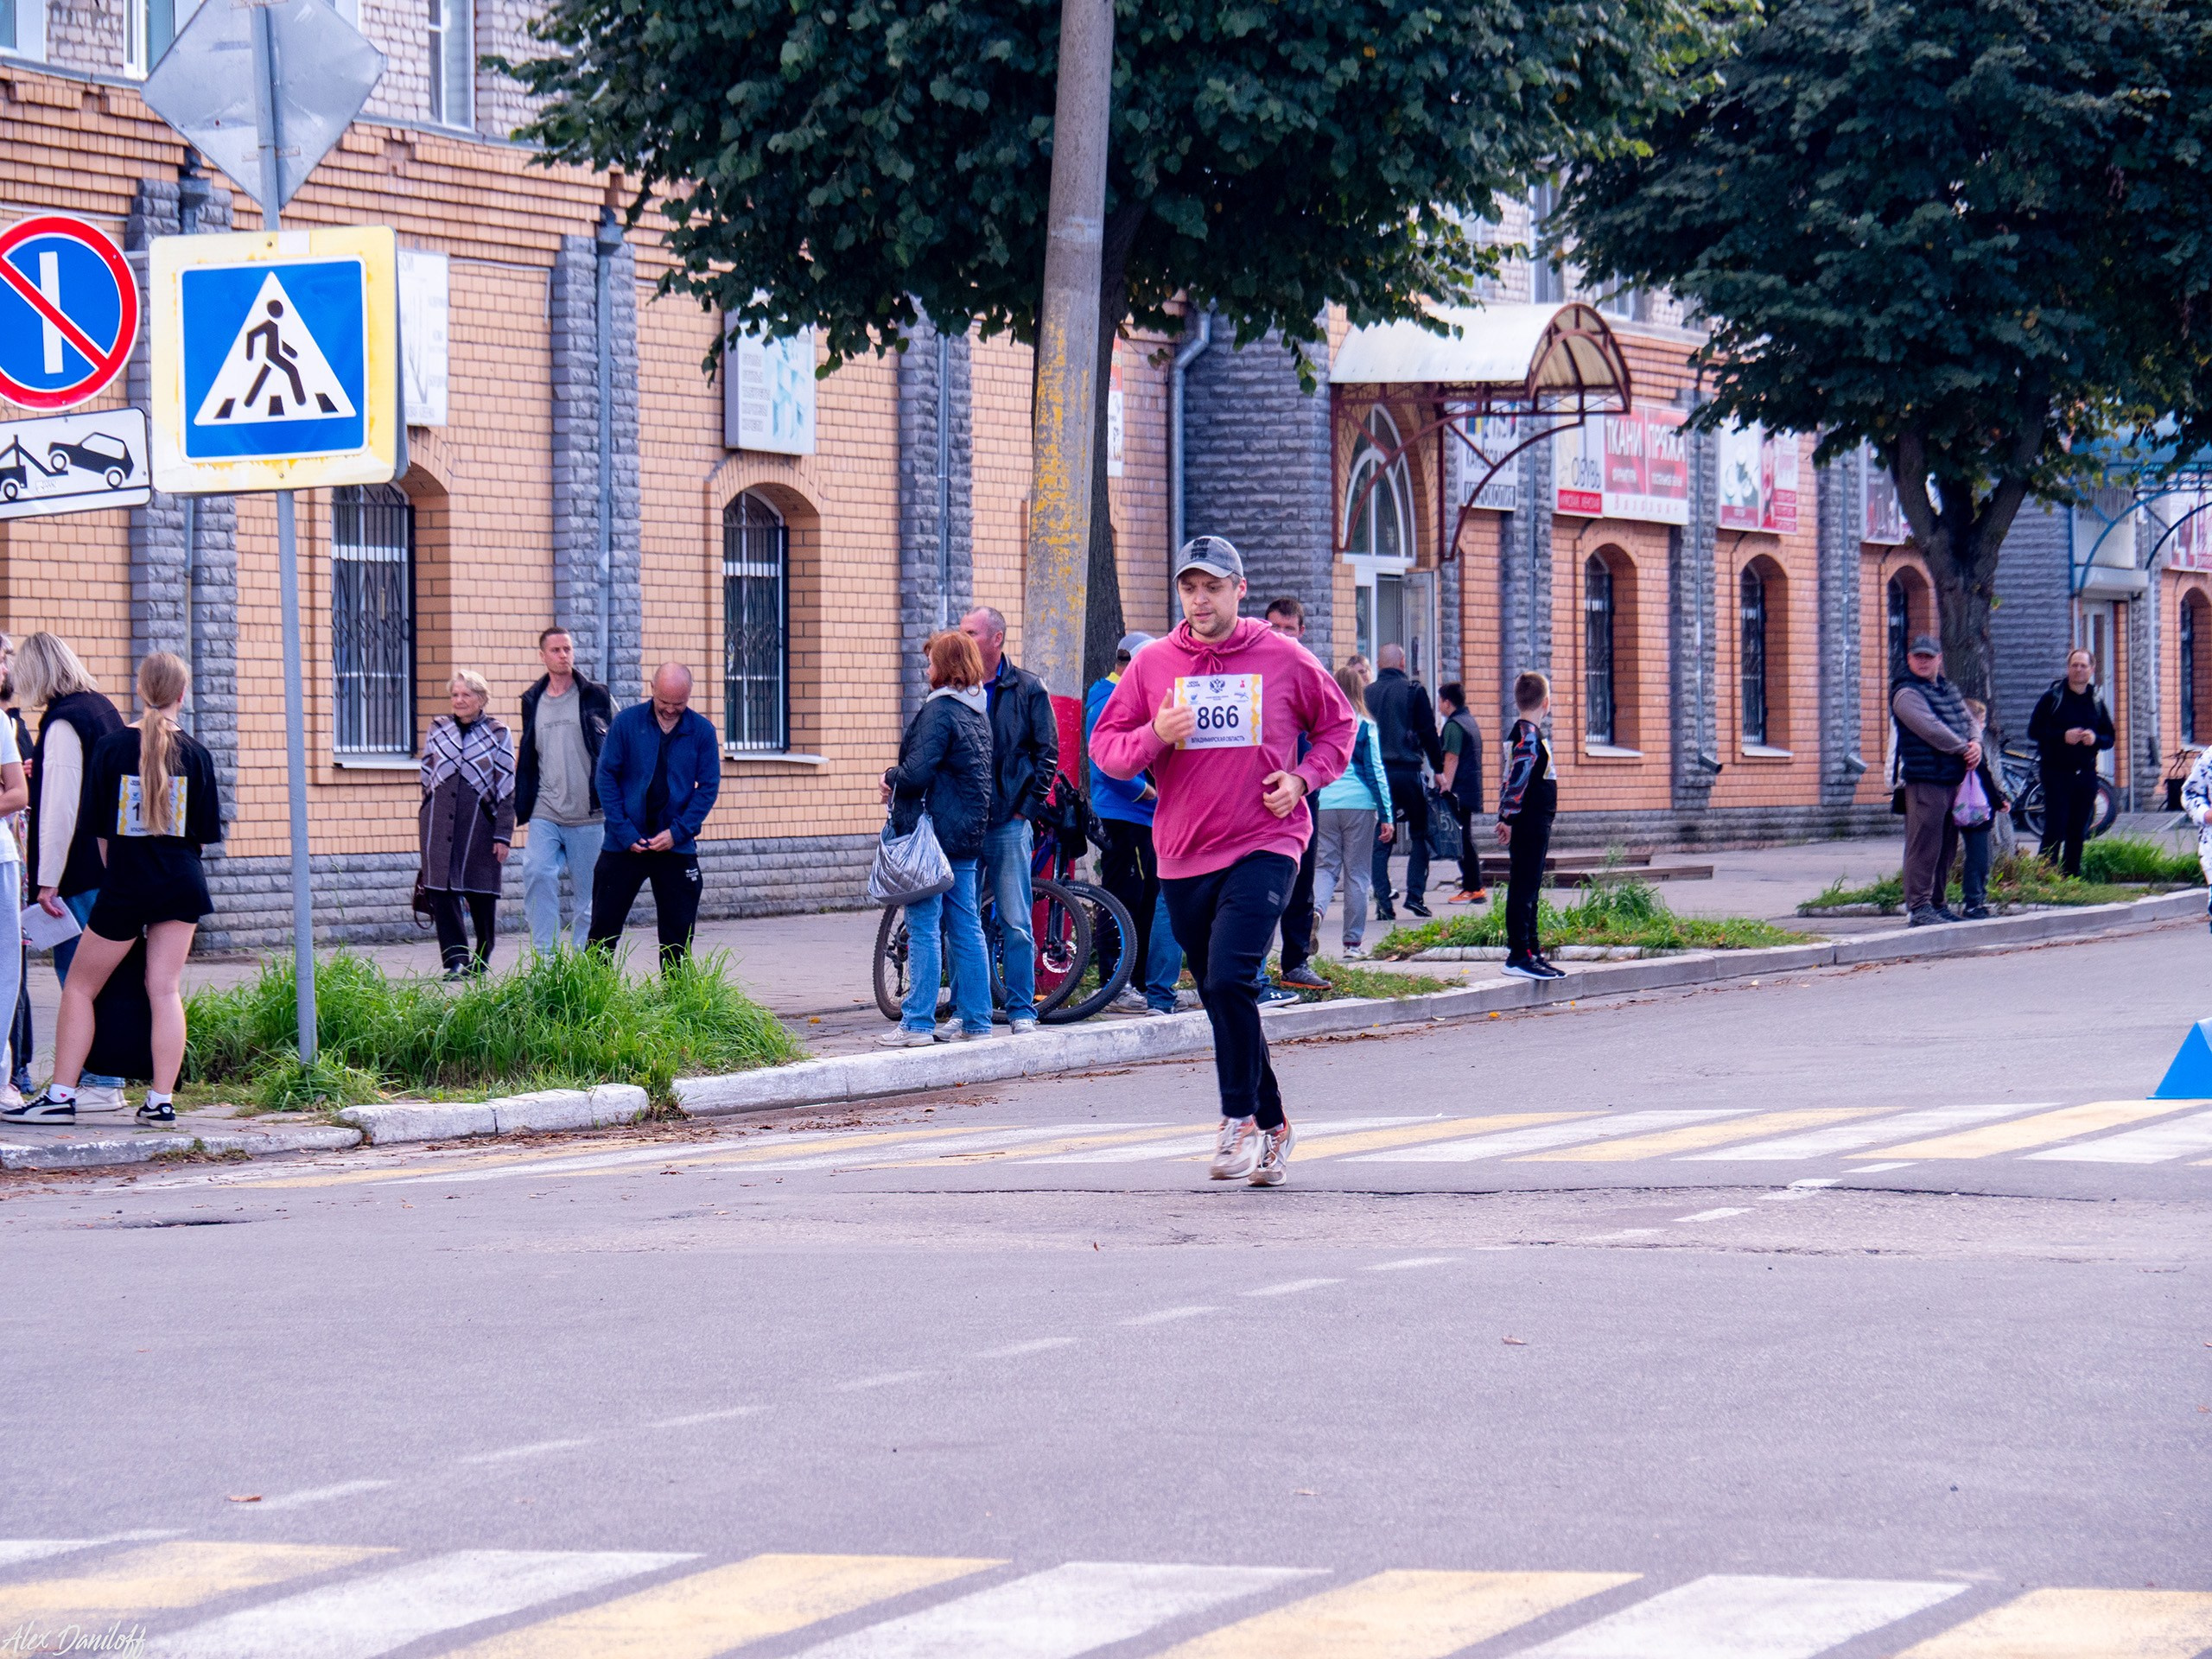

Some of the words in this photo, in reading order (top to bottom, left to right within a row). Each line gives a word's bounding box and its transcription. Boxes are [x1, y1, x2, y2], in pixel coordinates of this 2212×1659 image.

[1605, 418, 1643, 457] ТКАНИ
[1647, 423, 1686, 462] ПРЯЖА
[1197, 704, 1239, 730] 866
